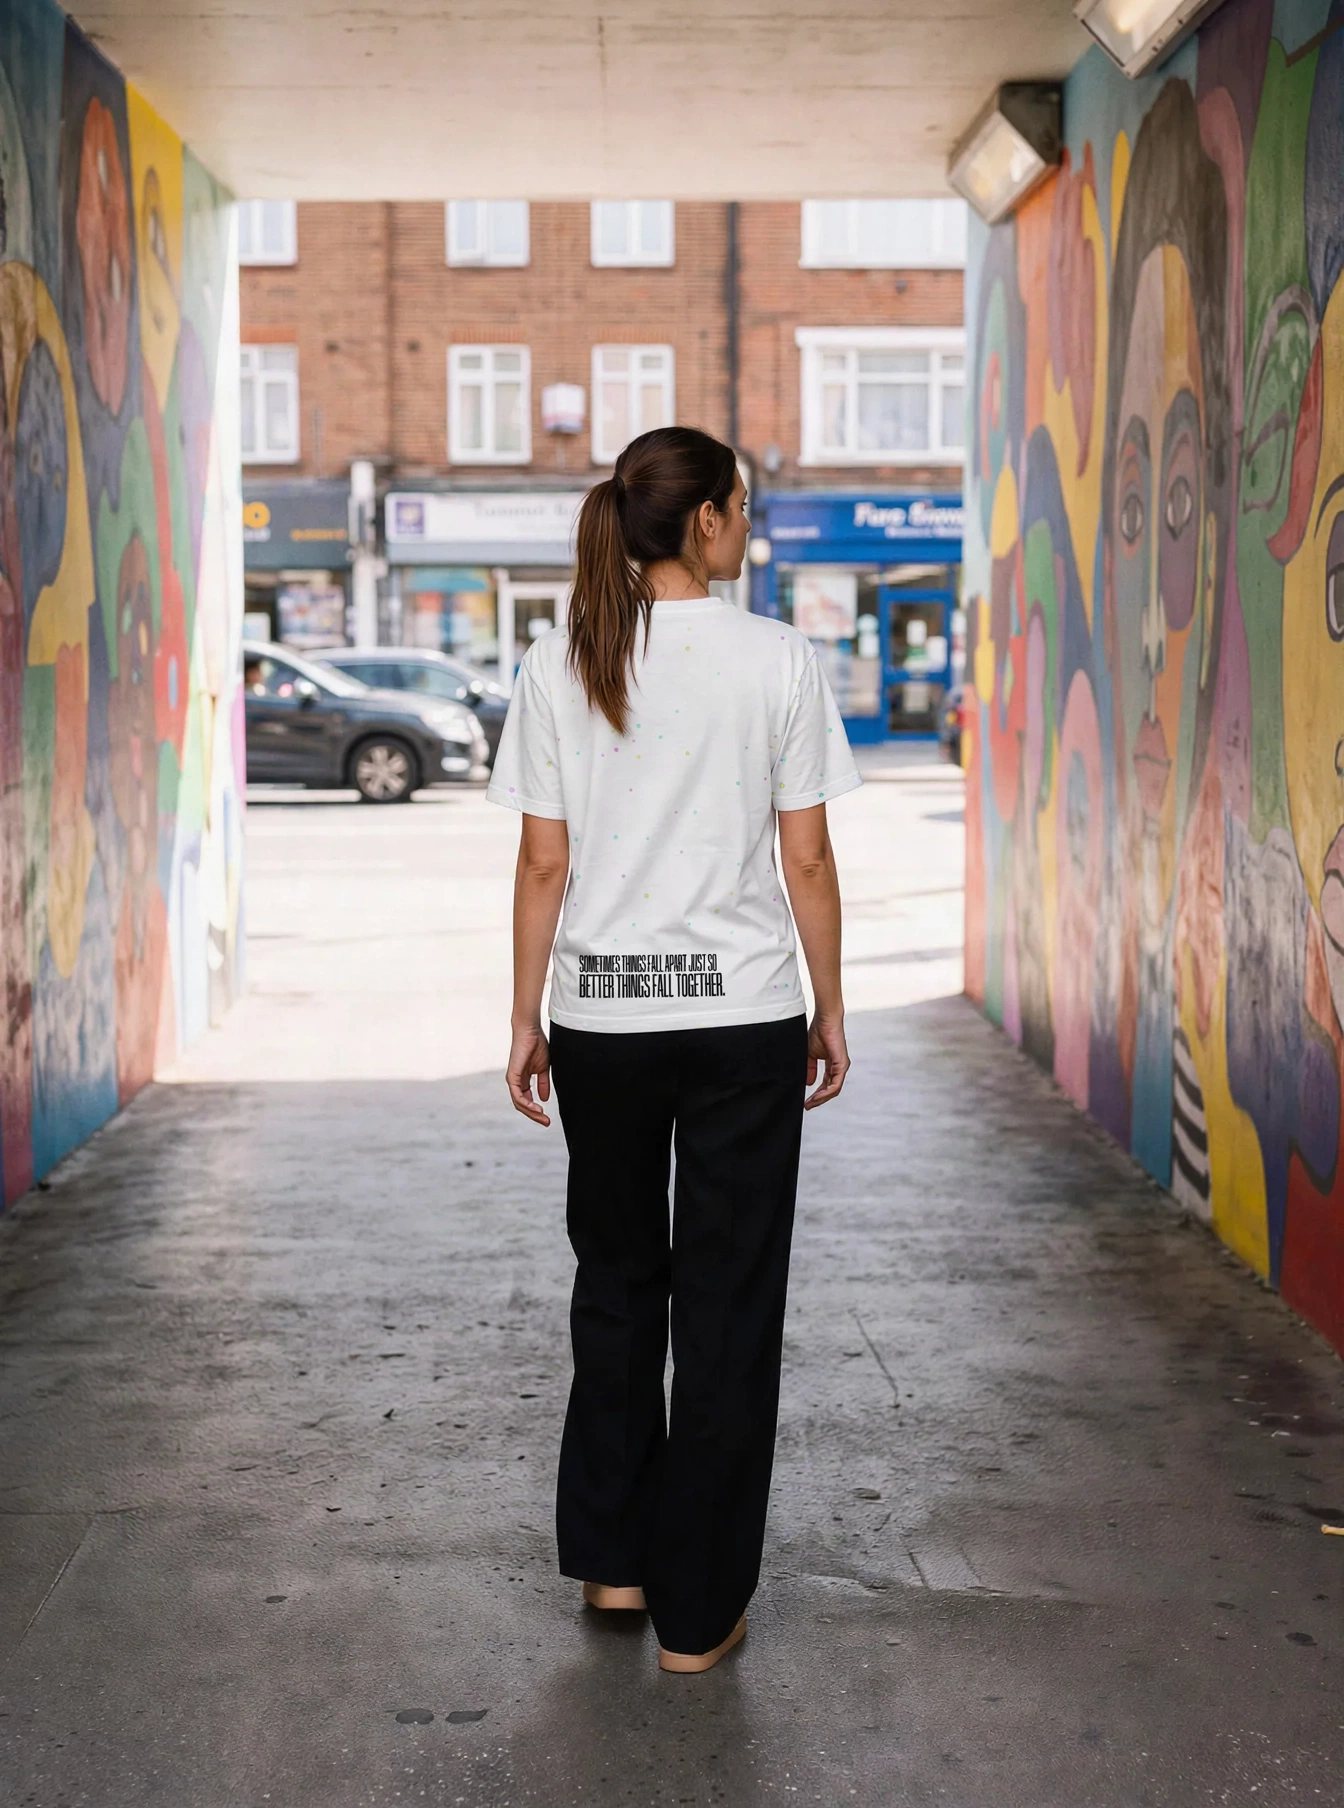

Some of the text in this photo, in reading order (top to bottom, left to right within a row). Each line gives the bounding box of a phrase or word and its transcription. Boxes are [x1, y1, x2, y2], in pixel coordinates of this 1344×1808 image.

[579, 953, 718, 973] SOMETIMES THINGS FALL APART JUST SO
[579, 972, 726, 998] BETTER THINGS FALL TOGETHER.
